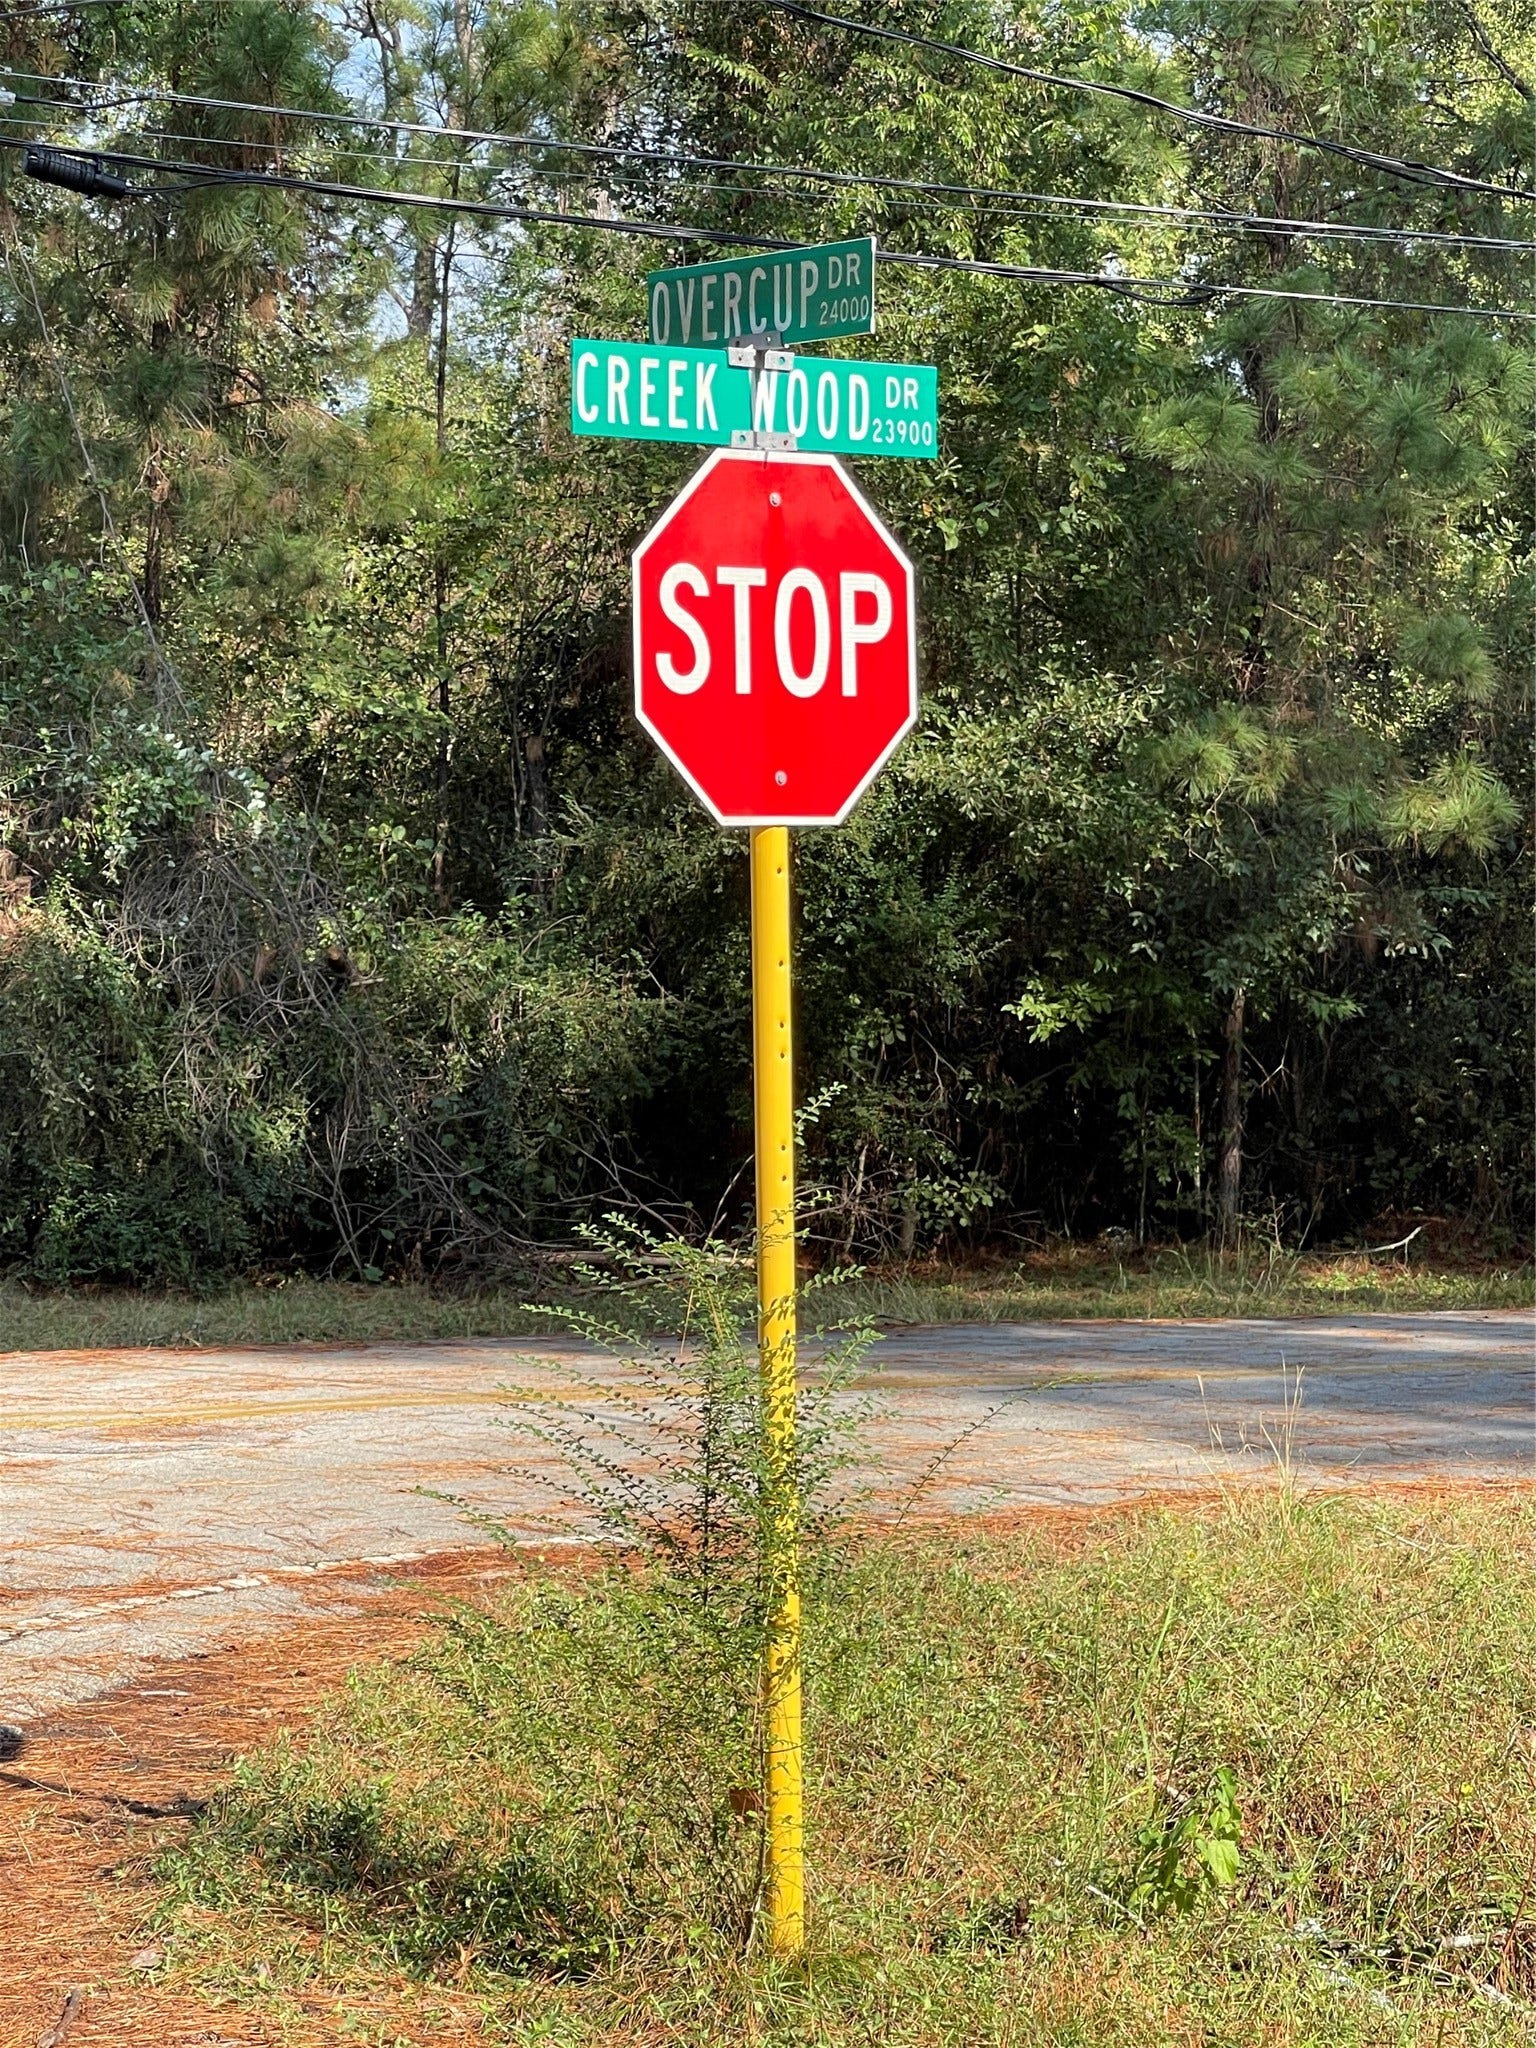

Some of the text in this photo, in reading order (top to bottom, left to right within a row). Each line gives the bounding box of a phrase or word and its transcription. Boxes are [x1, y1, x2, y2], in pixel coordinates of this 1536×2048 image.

[652, 253, 861, 345] OVERCUP DR
[819, 294, 869, 326] 24000
[576, 351, 919, 441] CREEK WOOD DR
[872, 418, 933, 446] 23900
[655, 562, 893, 699] STOP
